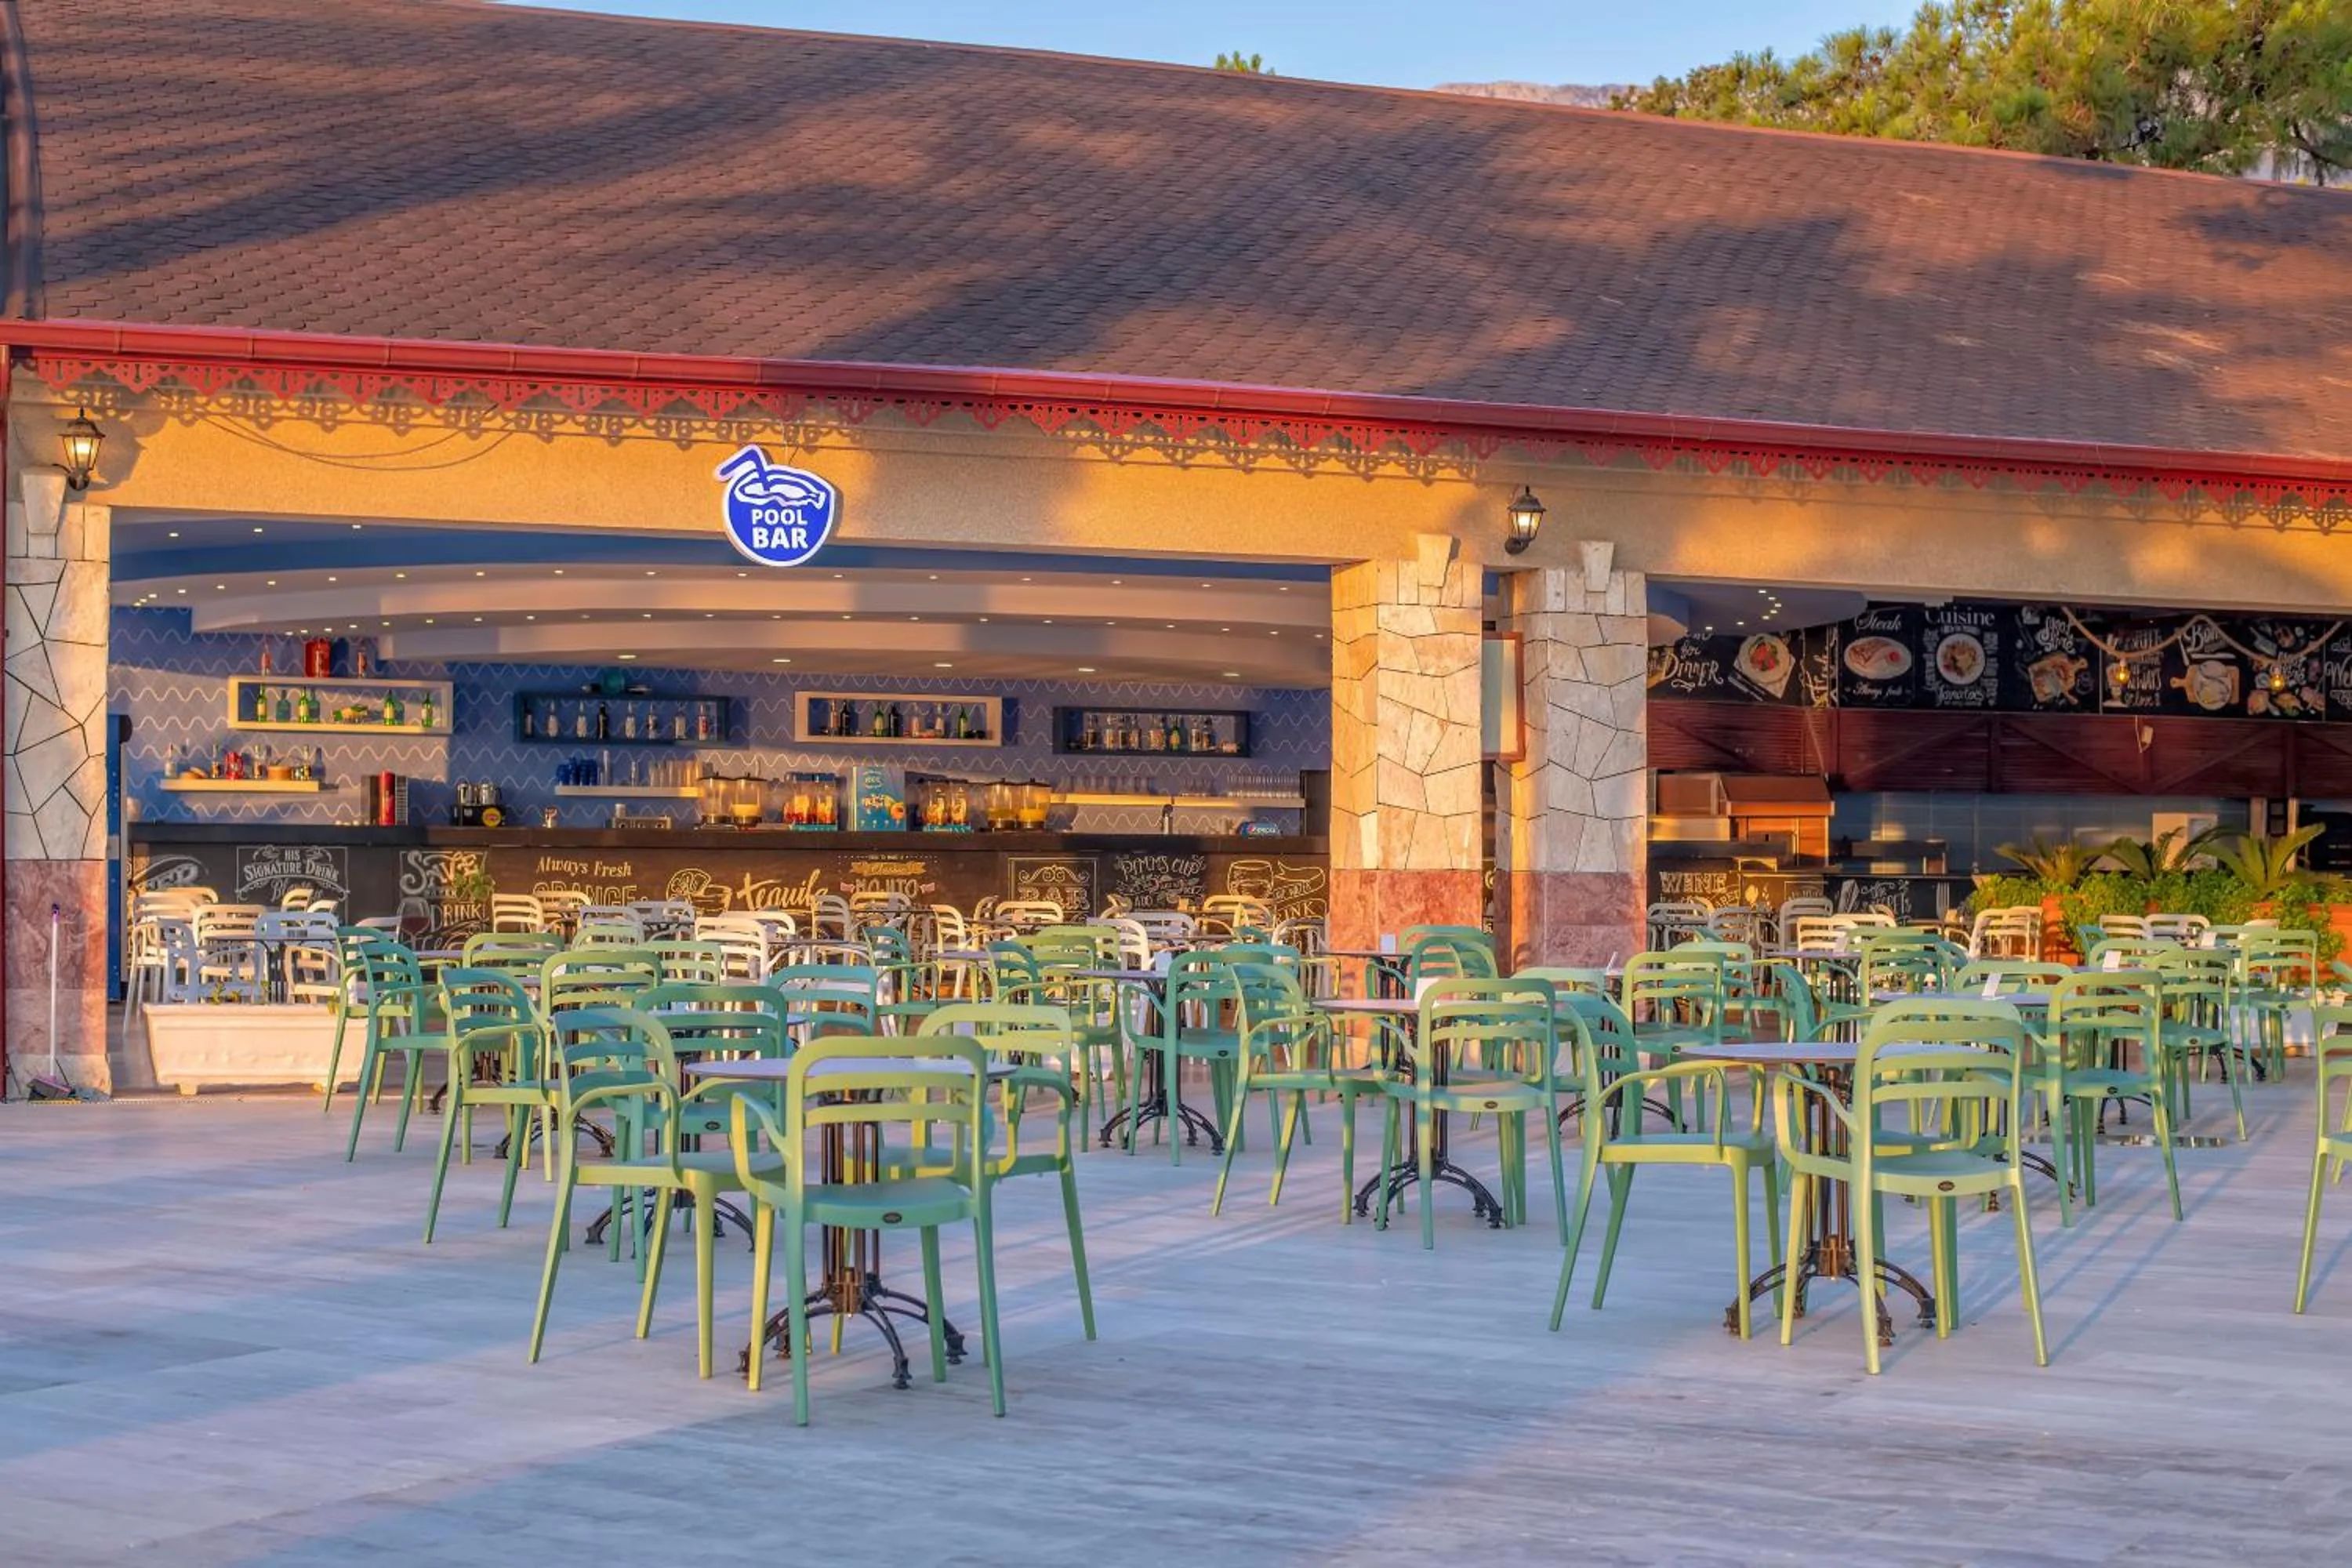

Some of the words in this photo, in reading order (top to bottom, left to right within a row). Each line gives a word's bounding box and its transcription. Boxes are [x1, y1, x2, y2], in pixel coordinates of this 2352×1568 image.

[752, 509, 808, 525] POOL
[753, 527, 809, 549] BAR
[1925, 605, 1996, 626] Cuisine
[285, 849, 300, 862] HIS
[536, 856, 588, 877] Always
[593, 860, 632, 877] Fresh
[1659, 871, 1727, 894] WINE
